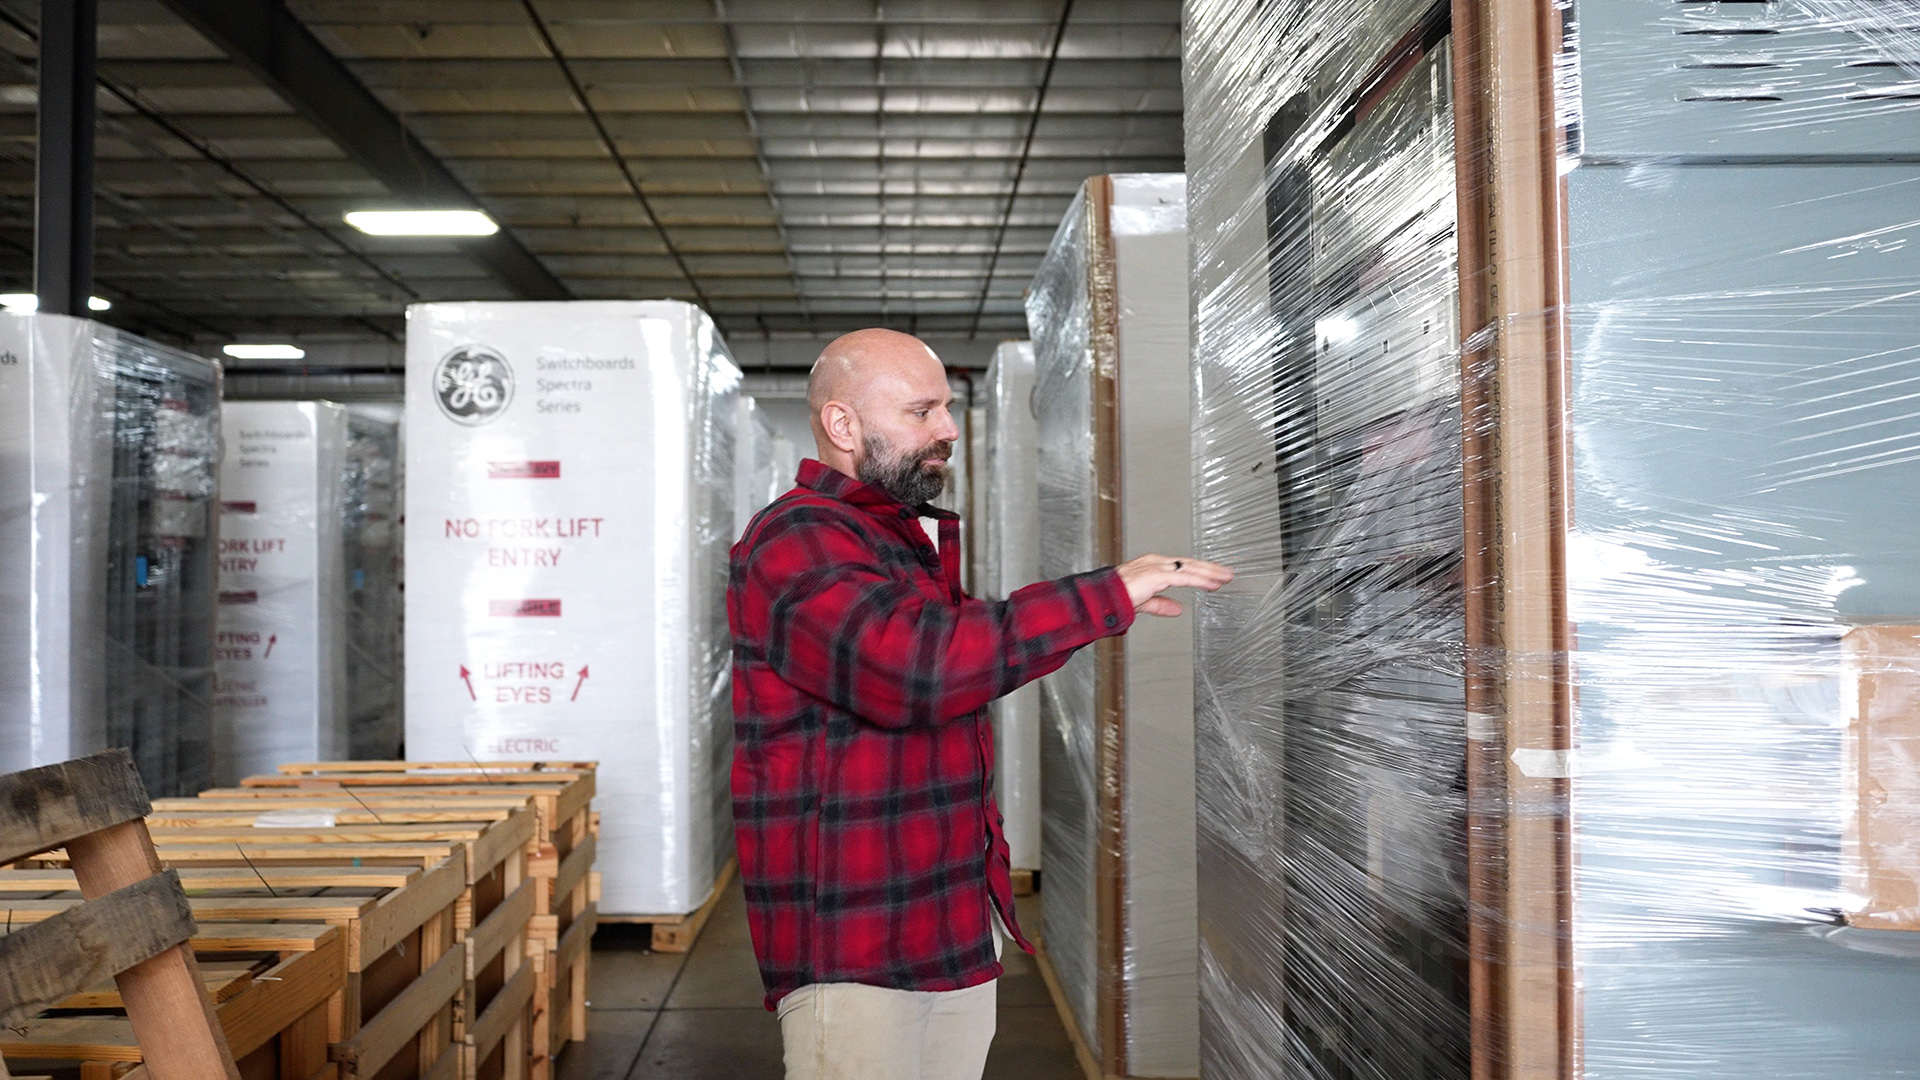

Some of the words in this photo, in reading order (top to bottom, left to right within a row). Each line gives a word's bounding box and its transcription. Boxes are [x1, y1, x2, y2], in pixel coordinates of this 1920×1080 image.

[1488, 193, 1498, 275] SALTILLO
[1490, 284, 1499, 307] GE
[536, 355, 635, 371] Switchboards
[536, 377, 592, 394] Spectra
[536, 401, 581, 414] Series
[445, 517, 480, 538] NO
[488, 518, 549, 538] FORK
[557, 518, 604, 538] LIFT
[219, 538, 249, 553] ORK
[253, 538, 285, 553] LIFT
[219, 558, 258, 572] NTRY
[488, 548, 562, 567] ENTRY
[484, 662, 565, 679] LIFTING
[496, 686, 551, 703] EYES
